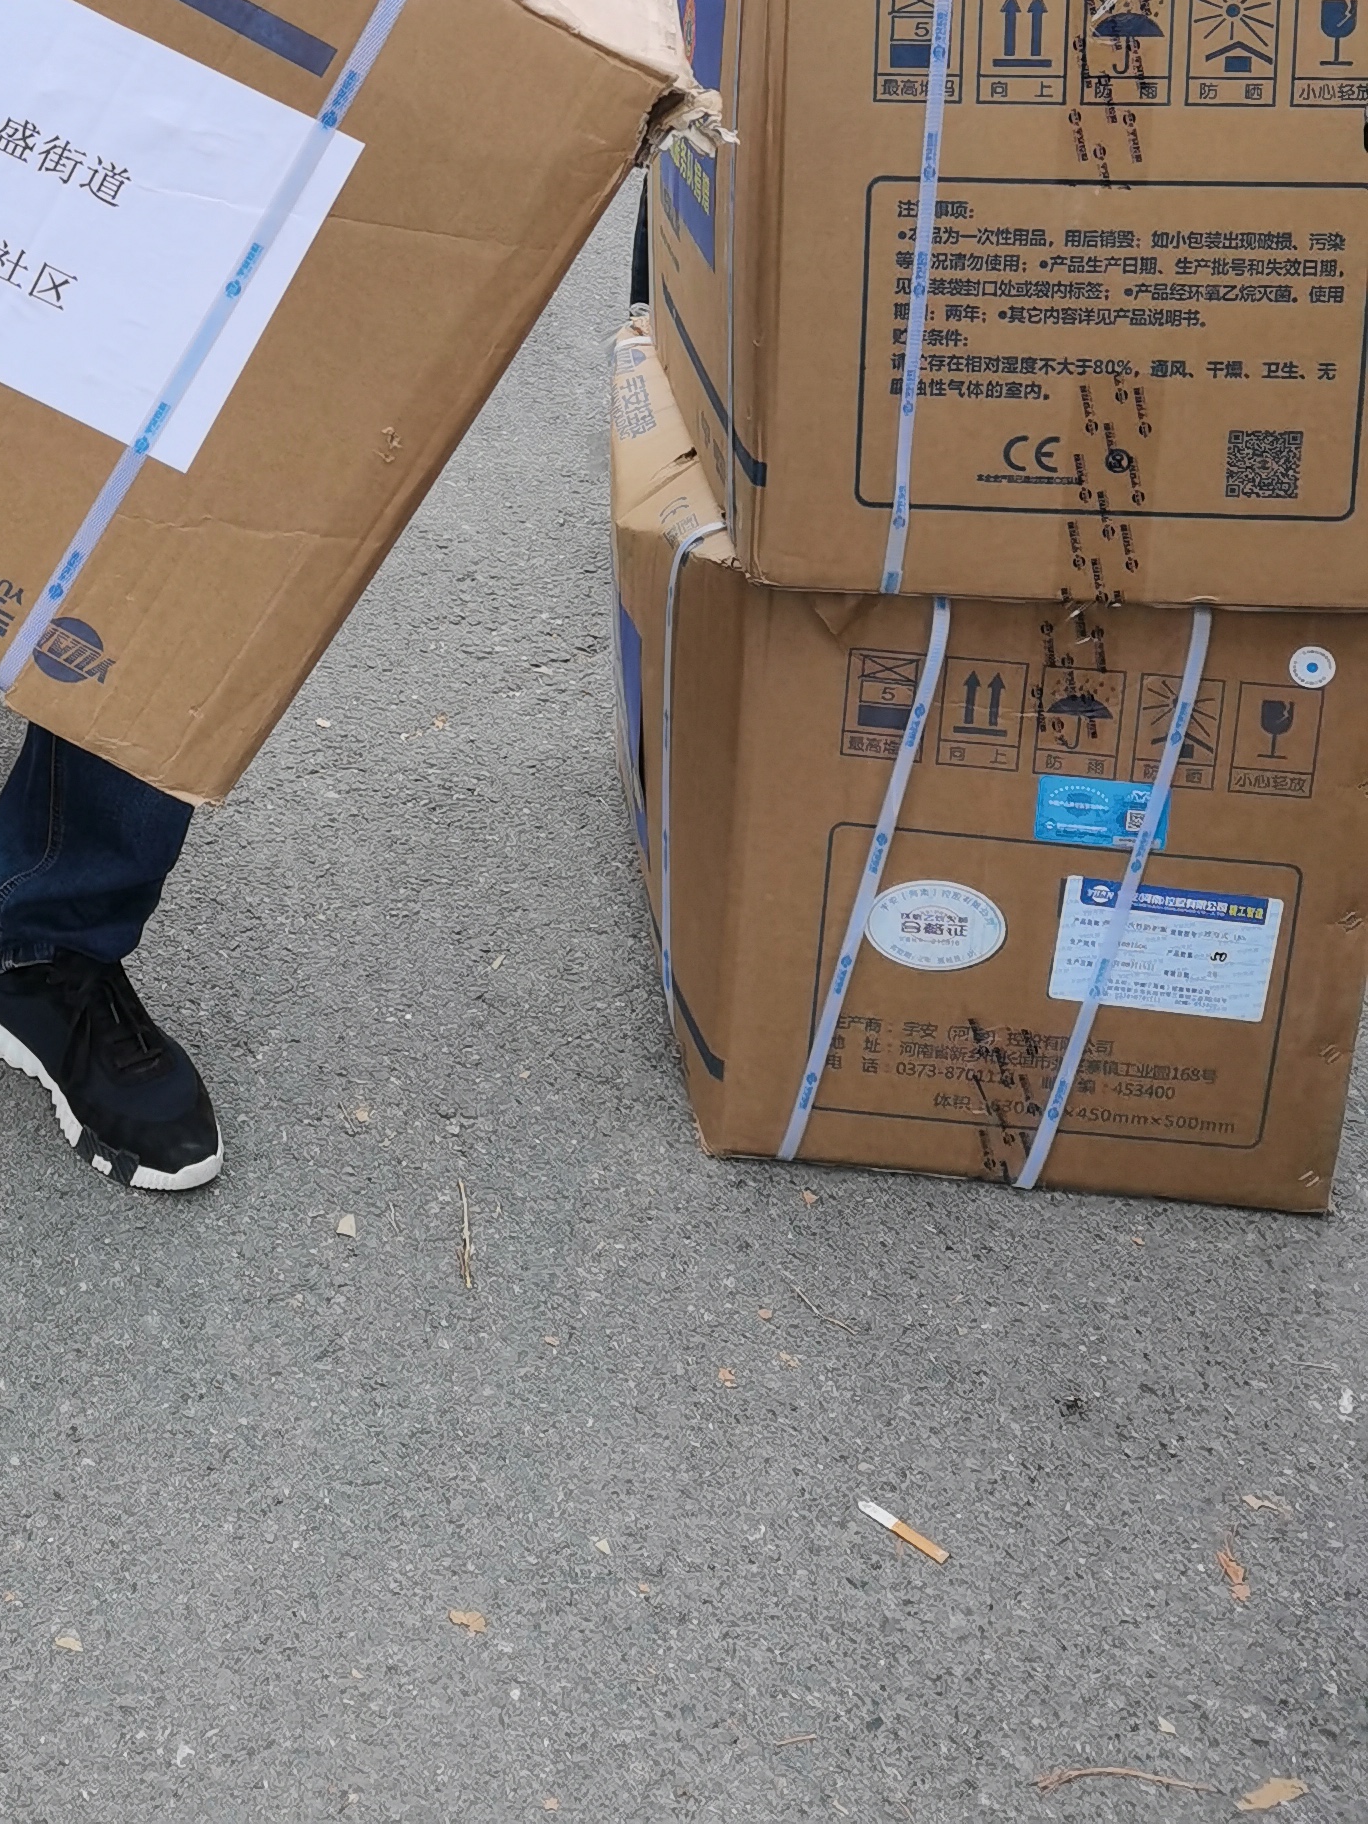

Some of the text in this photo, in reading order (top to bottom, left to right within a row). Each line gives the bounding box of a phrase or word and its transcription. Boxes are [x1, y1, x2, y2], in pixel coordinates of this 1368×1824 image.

[913, 21, 929, 37] 5
[897, 199, 974, 219] 注事项：
[1003, 434, 1061, 473] CE
[880, 687, 896, 702] 5
[1234, 773, 1307, 794] 小心轻放
[1112, 1080, 1176, 1100] 453400
